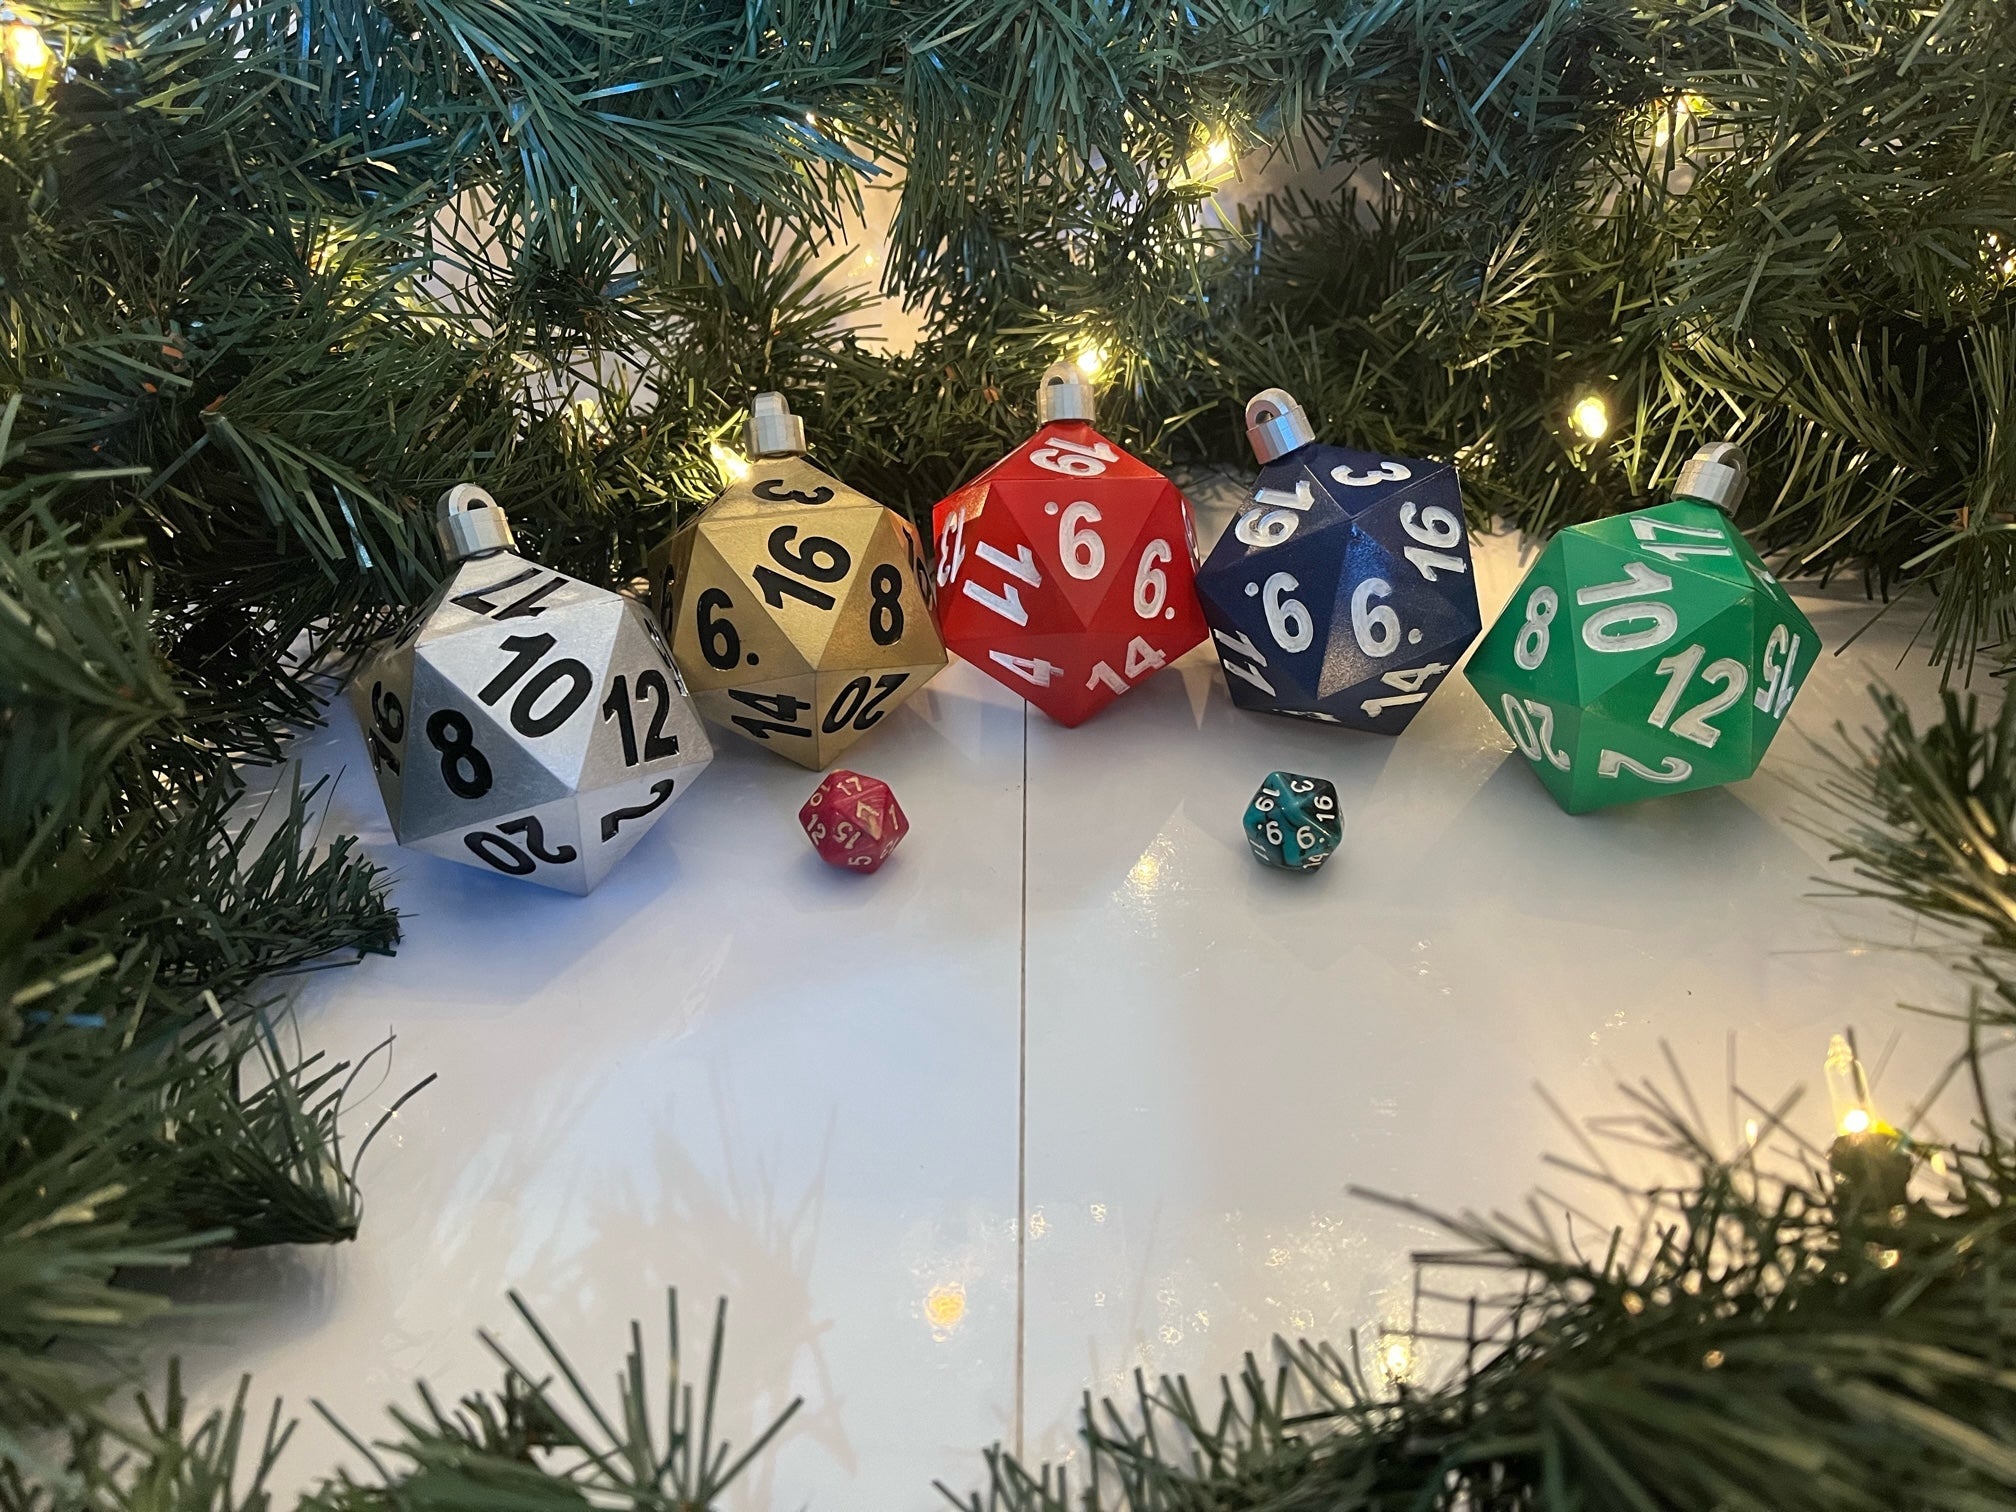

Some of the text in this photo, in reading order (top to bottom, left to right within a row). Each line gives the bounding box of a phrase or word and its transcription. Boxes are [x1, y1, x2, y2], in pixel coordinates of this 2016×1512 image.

[1029, 437, 1119, 476] 19
[1331, 462, 1411, 486] 3
[752, 479, 834, 505] 3
[1235, 480, 1315, 547] 19
[753, 525, 851, 610] 16
[1400, 502, 1467, 581] 16
[1629, 517, 1734, 561] 17
[450, 567, 570, 621] 17
[869, 563, 904, 646] 8
[963, 540, 1042, 626] 11
[1576, 562, 1678, 653] 10
[1513, 586, 1558, 670] 8
[477, 633, 593, 738] 10
[989, 649, 1064, 687] 4
[1085, 635, 1166, 695] 14
[1214, 629, 1276, 697] 11
[1360, 663, 1450, 717] 14
[1754, 624, 1800, 719] 15
[602, 669, 680, 768] 12
[728, 689, 812, 739] 14
[822, 673, 910, 733] 20
[1648, 644, 1748, 748] 12
[426, 709, 493, 799] 8
[1501, 693, 1571, 772] 20
[836, 776, 862, 796] 17
[1255, 788, 1280, 812] 19
[1290, 780, 1315, 793] 3
[1314, 795, 1335, 822] 16
[463, 815, 577, 876] 20
